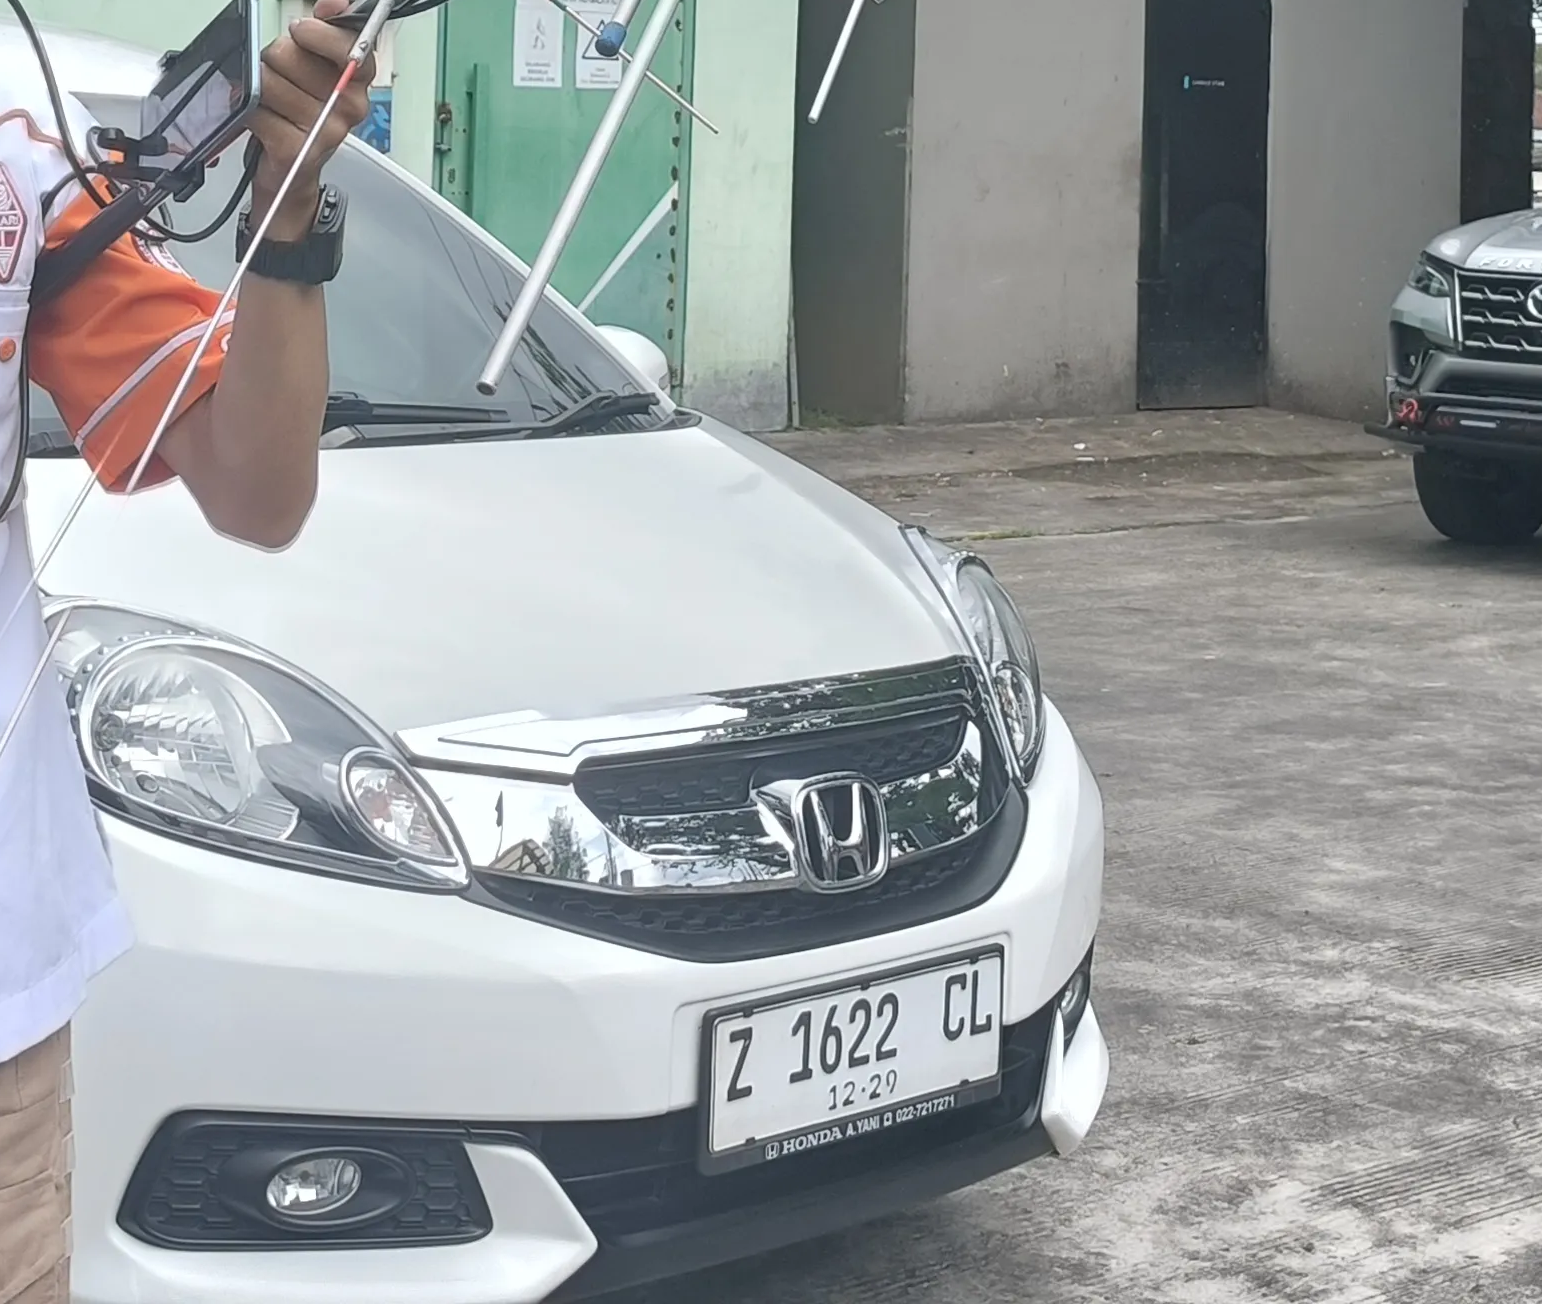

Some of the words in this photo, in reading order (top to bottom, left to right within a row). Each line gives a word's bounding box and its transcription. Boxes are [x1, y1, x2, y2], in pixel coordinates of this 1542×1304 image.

[727, 1027, 753, 1102] Z
[789, 992, 900, 1084] 1622
[943, 969, 992, 1041] CL
[781, 1126, 843, 1155] HONDA
[895, 1094, 955, 1125] 022-7217271
